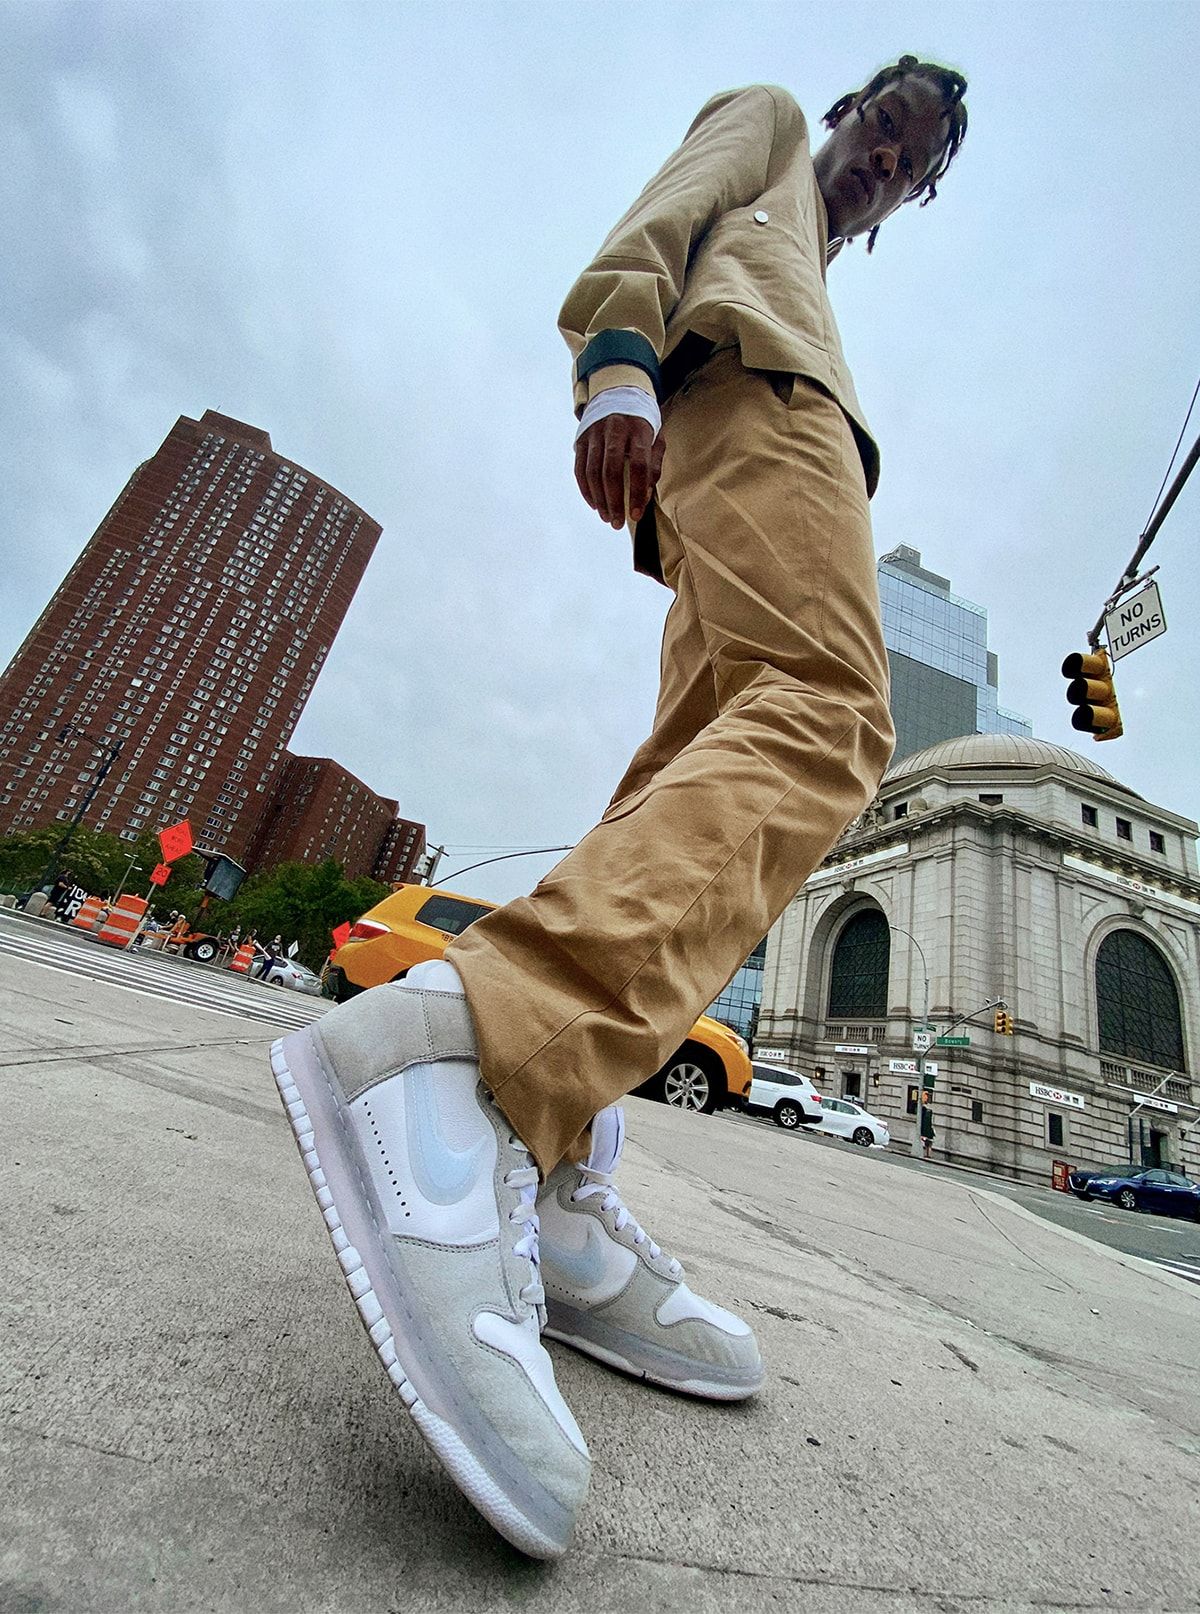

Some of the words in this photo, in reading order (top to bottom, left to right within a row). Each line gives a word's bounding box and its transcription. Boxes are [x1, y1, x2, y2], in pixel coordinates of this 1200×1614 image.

[1120, 602, 1144, 627] NO
[1112, 613, 1162, 651] TURNS
[155, 867, 168, 877] 20
[893, 1062, 909, 1071] HSBC
[1035, 1086, 1053, 1098] HSBC
